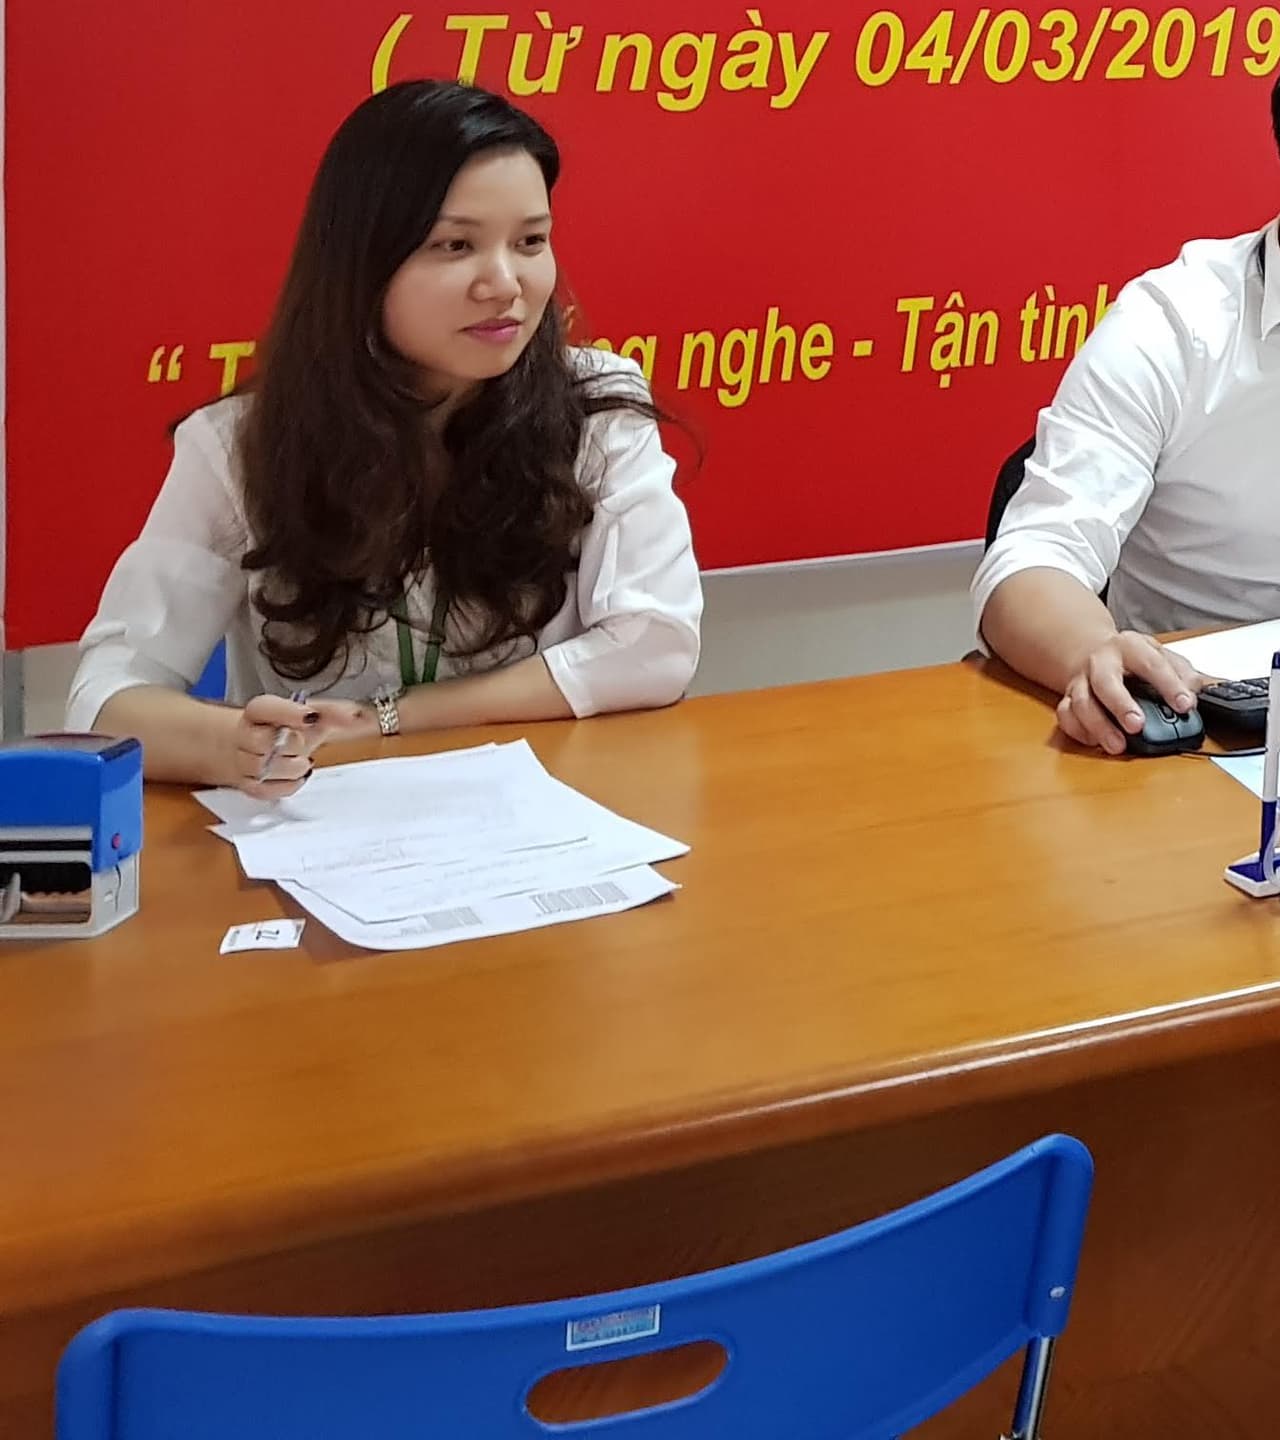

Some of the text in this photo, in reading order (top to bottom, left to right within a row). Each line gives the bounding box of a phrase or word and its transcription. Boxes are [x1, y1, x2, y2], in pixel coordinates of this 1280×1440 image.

[444, 10, 583, 97] Từ
[596, 9, 830, 113] ngày
[677, 307, 835, 408] nghe
[896, 291, 1000, 389] Tận
